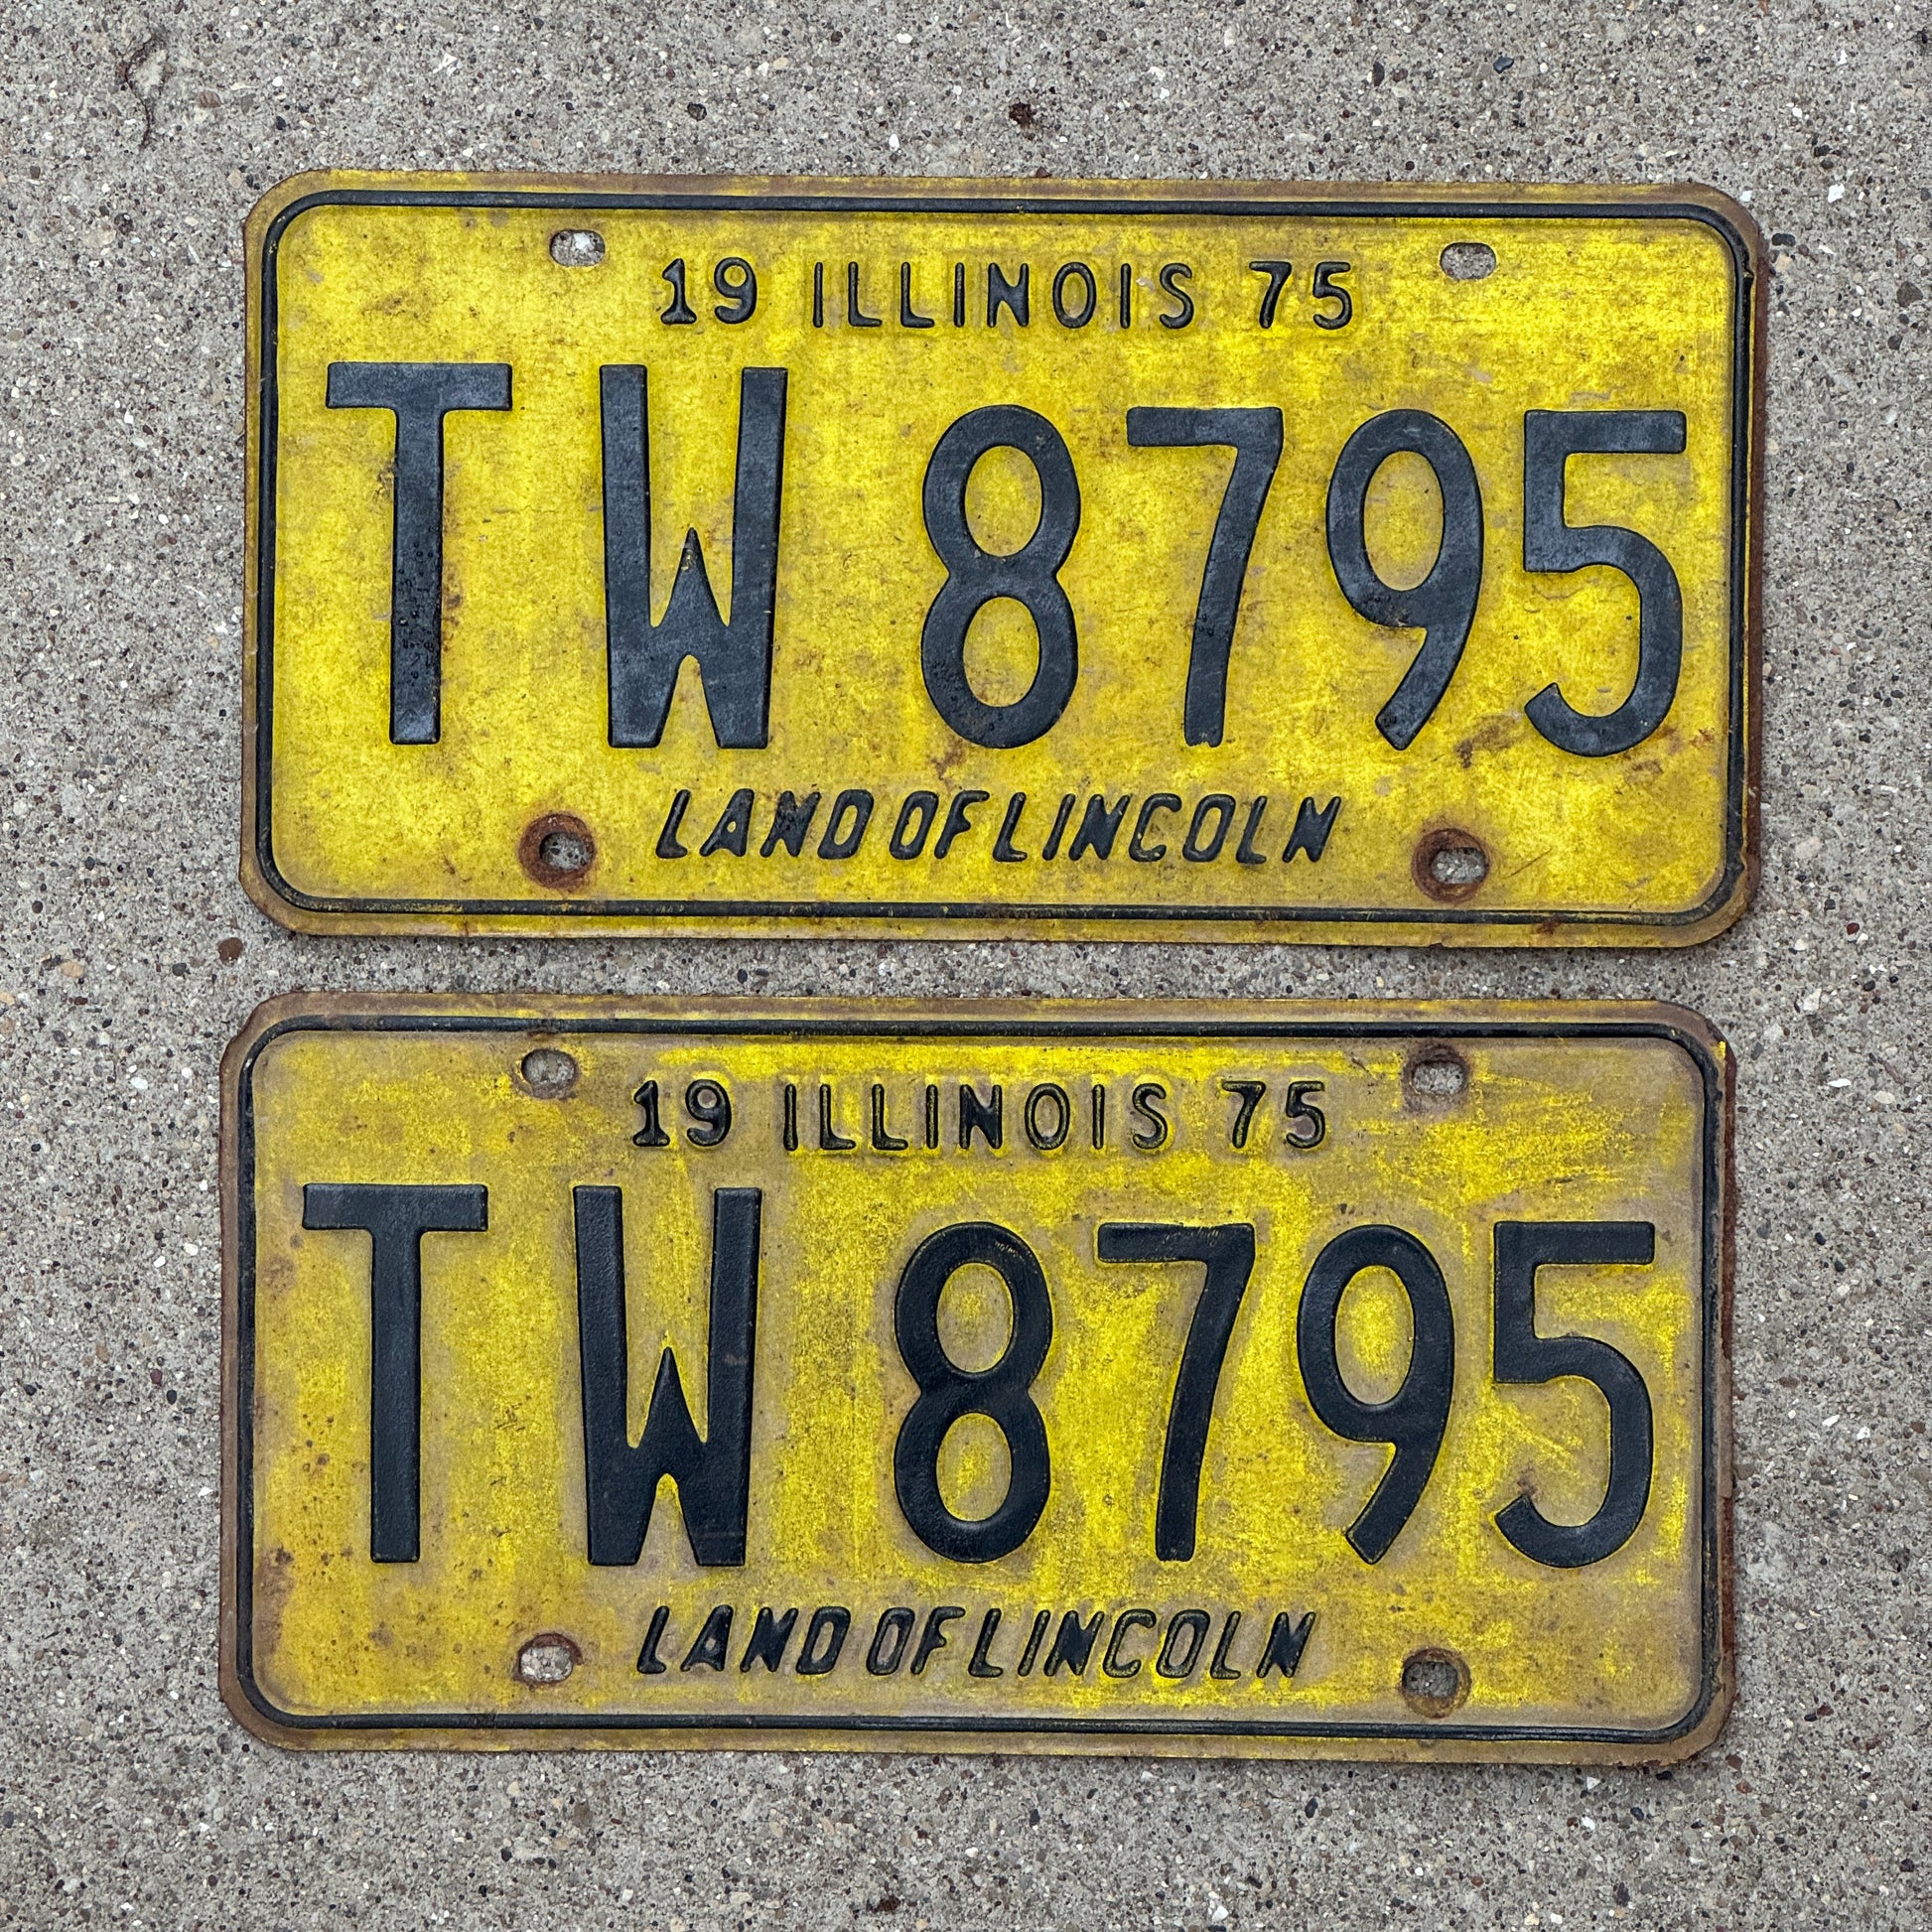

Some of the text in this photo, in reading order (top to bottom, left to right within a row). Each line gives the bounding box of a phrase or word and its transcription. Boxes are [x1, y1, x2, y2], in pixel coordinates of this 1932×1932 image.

[662, 258, 1352, 329] 19 ILLINOIS 75
[327, 363, 1686, 756] TW 8795
[656, 789, 1341, 865] LAND OF LINCOLN
[633, 1080, 1325, 1151] 19 ILLINOIS 75
[303, 1184, 1655, 1569] TW 8795
[637, 1606, 1316, 1679] LAND OF LINCOLN
